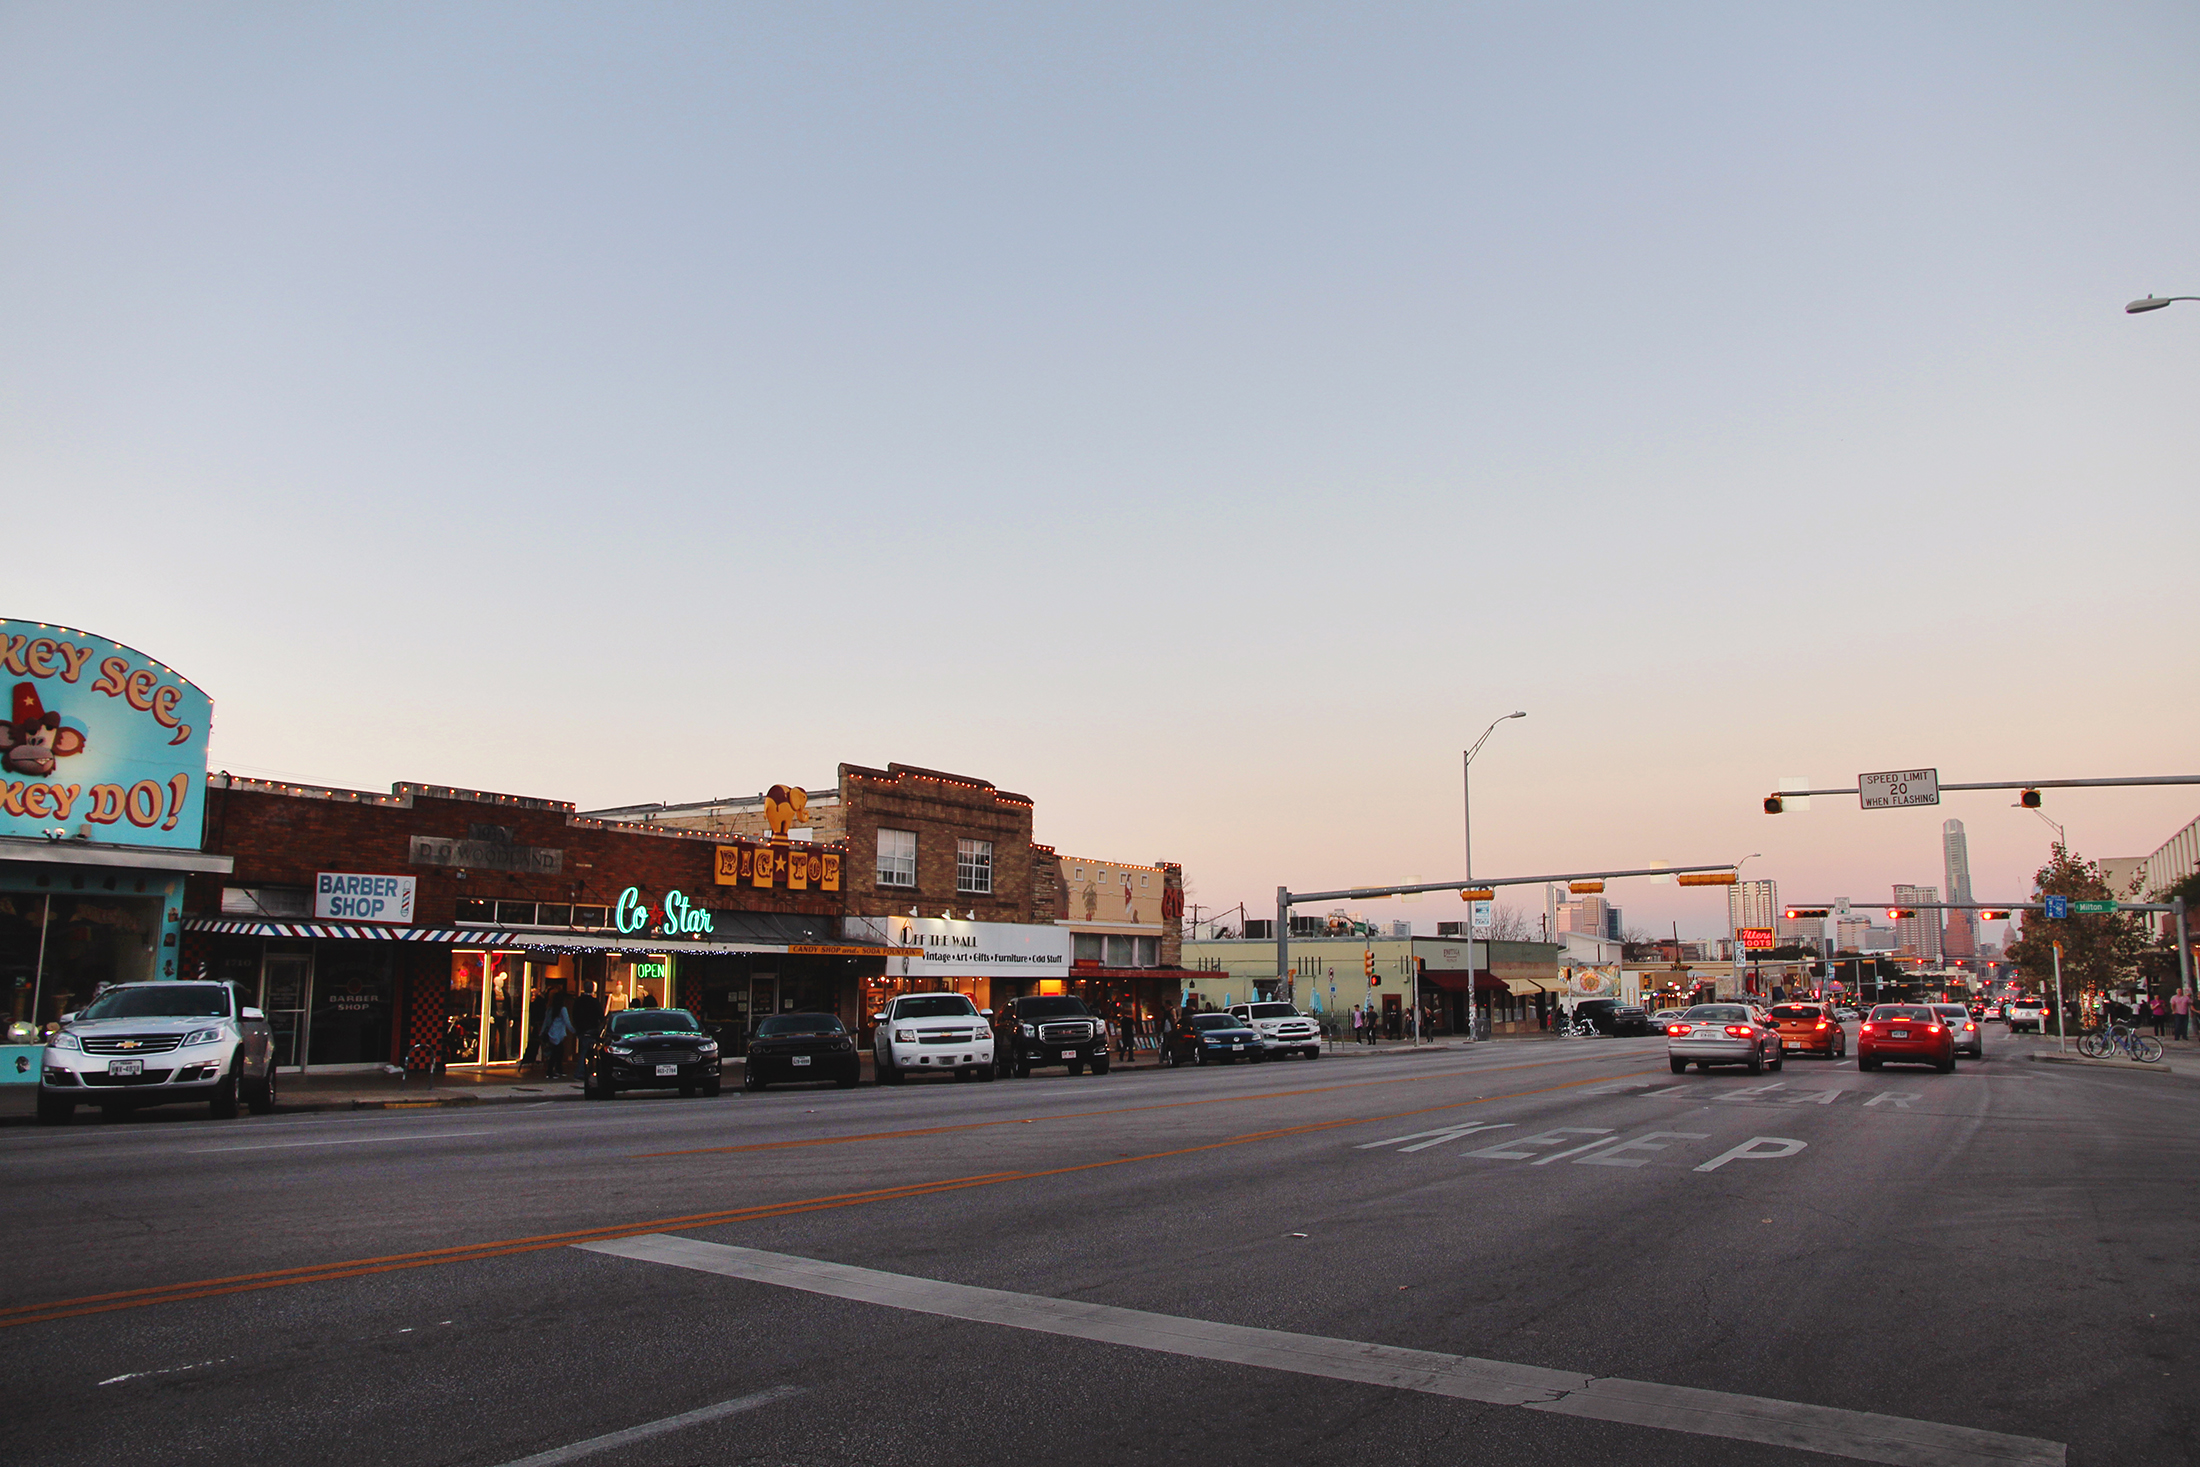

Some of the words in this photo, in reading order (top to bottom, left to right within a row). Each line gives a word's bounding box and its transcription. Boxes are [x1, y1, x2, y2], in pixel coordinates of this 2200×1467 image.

[91, 656, 192, 746] SEE,
[1867, 774, 1898, 784] SPEED
[1903, 771, 1928, 782] LIMIT
[1889, 782, 1908, 795] 20
[85, 772, 189, 832] DO!
[1865, 797, 1889, 806] WHEN
[1892, 793, 1935, 805] FLASHING
[457, 846, 555, 869] WOODLAND
[719, 849, 774, 877] BIG
[791, 855, 839, 882] TOP
[319, 874, 398, 897] BARBER
[330, 897, 385, 917] SHOP
[615, 887, 648, 934] Co
[664, 889, 714, 935] Star
[2079, 903, 2103, 911] Milton
[928, 935, 949, 946] THE
[952, 935, 978, 948] WALL
[792, 945, 818, 953] CANDY
[821, 946, 841, 954] SHOP
[882, 948, 916, 956] FOUNTAIN
[955, 953, 969, 962] Art
[973, 953, 990, 963] Gifts
[994, 953, 1028, 963] Furniture
[1047, 954, 1063, 964] Stuff
[637, 963, 665, 978] OPEN
[329, 995, 379, 1003] BARBER
[337, 1003, 370, 1011] SHOP
[1353, 1121, 1808, 1172] KEEP
